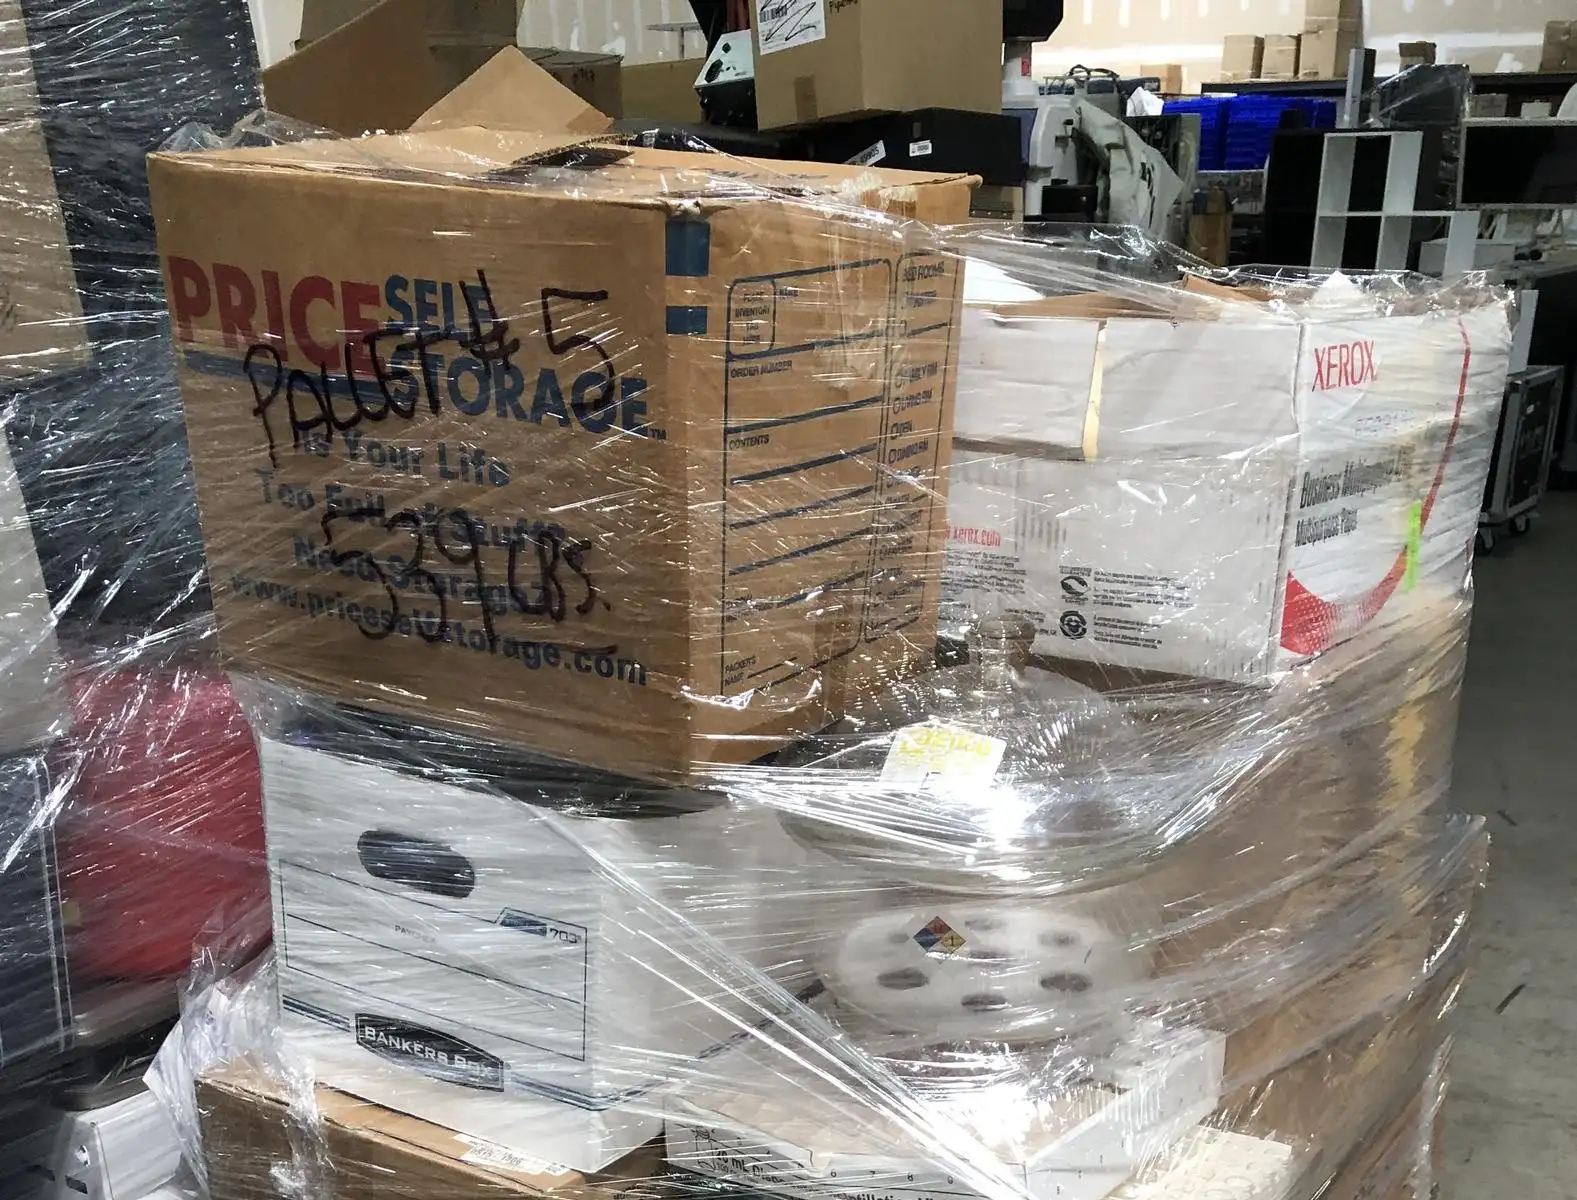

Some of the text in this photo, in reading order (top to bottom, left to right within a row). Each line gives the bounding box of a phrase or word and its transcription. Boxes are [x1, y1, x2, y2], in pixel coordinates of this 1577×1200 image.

[167, 256, 385, 378] PRICE
[1312, 339, 1378, 392] XEROX
[387, 350, 651, 440] STORAGE
[345, 430, 424, 474] Your
[437, 441, 510, 488] Life
[365, 1026, 449, 1065] BANKERS
